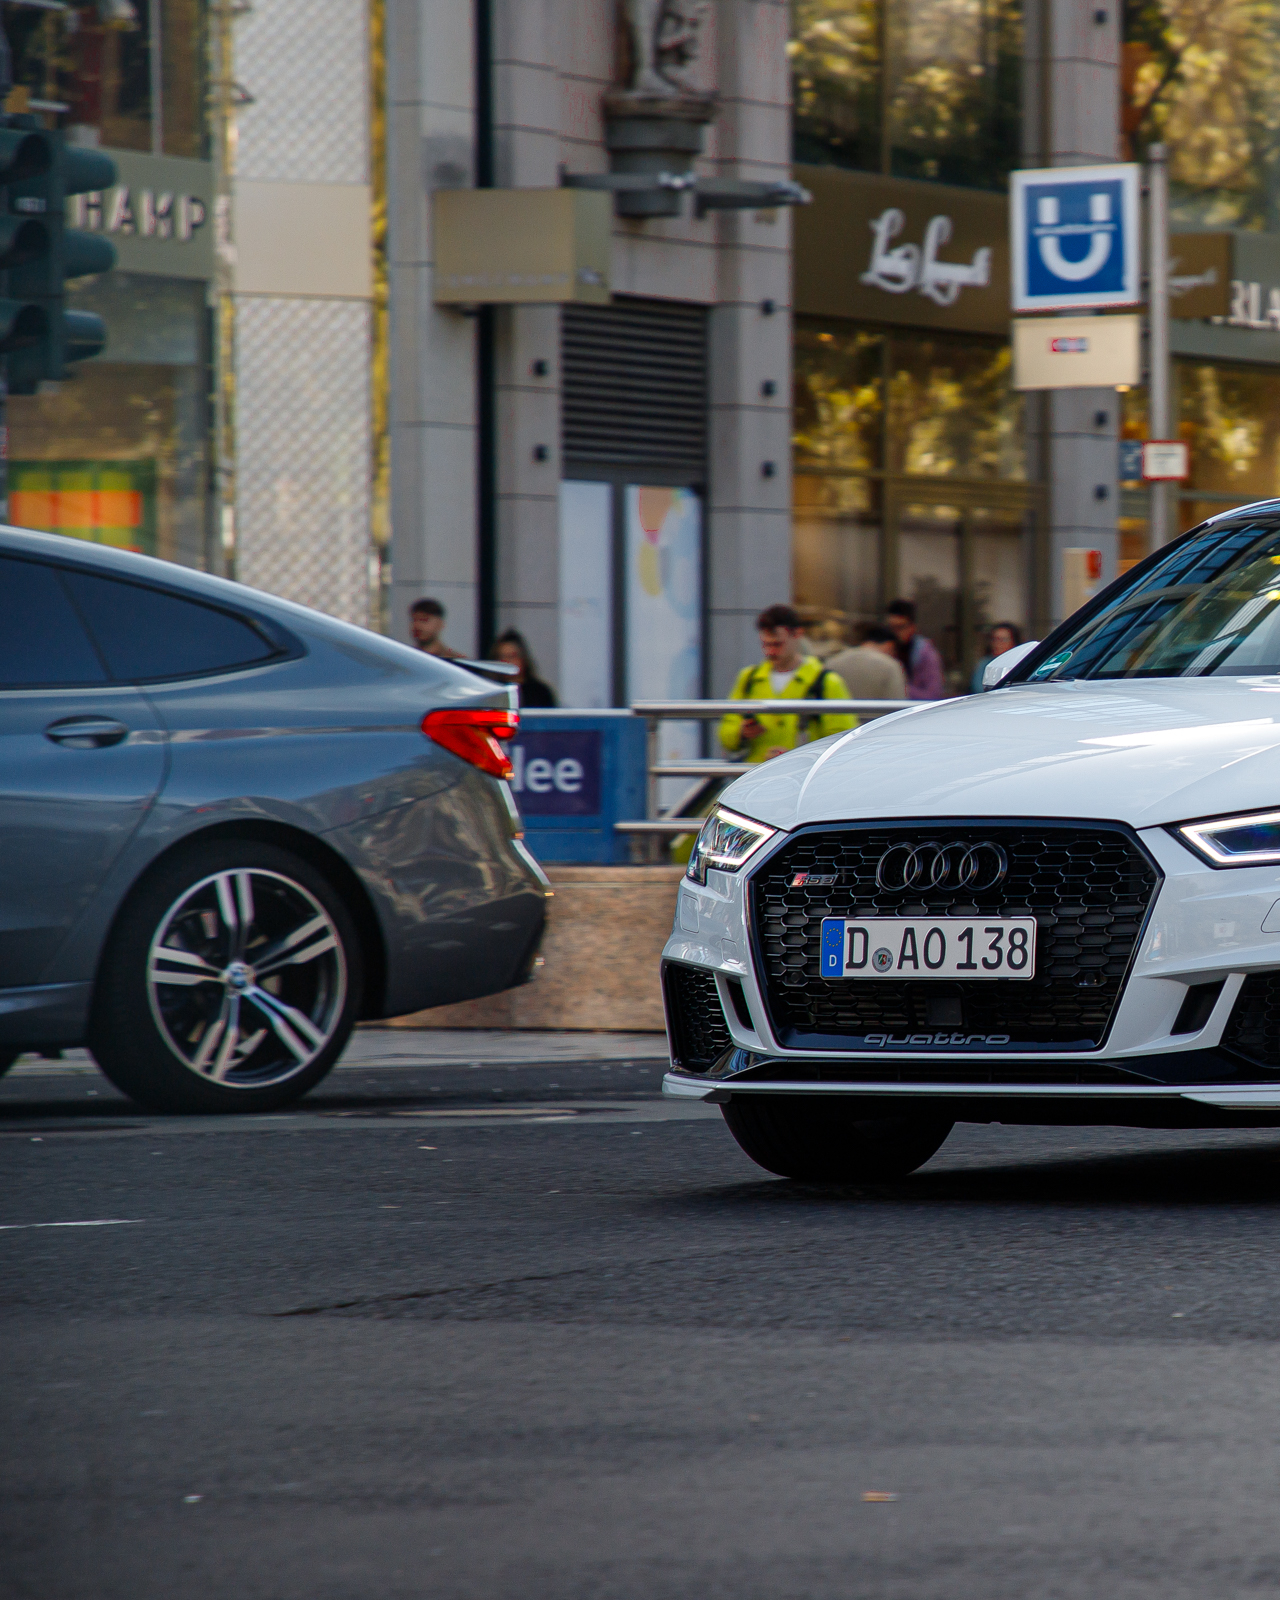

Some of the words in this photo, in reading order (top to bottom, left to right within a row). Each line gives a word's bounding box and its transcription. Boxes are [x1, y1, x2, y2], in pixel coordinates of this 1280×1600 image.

[1037, 193, 1113, 282] U
[828, 954, 838, 967] D
[845, 927, 869, 970] D
[897, 926, 947, 970] AO
[956, 926, 1029, 970] 138
[863, 1031, 1011, 1048] quattro
